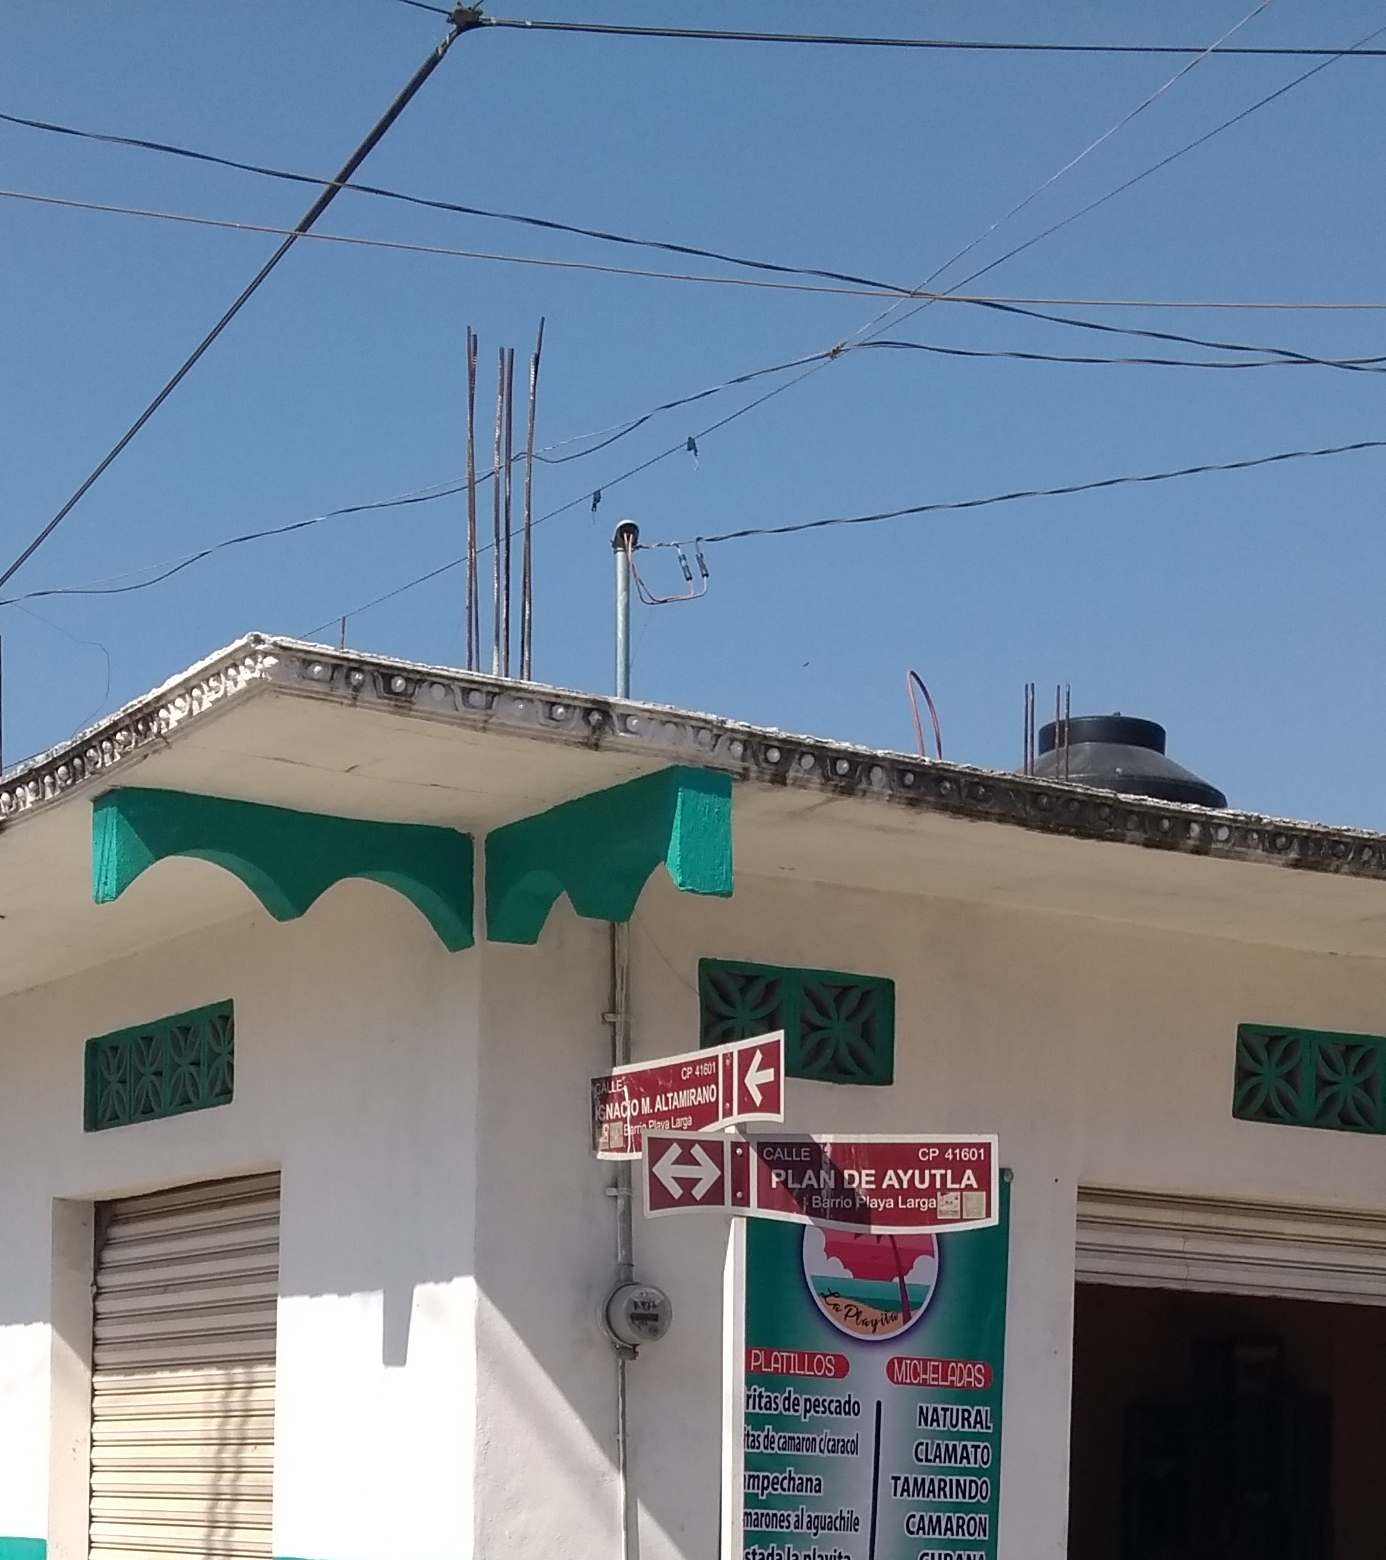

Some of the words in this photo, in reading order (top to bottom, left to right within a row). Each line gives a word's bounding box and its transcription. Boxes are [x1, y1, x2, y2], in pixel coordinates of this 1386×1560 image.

[695, 1061, 716, 1077] 41601
[595, 1079, 623, 1095] CALLE
[595, 1099, 639, 1122] IGNACIO
[641, 1096, 653, 1115] M.
[655, 1084, 717, 1112] ALTAMIRANO
[624, 1122, 647, 1136] Barrio
[648, 1119, 670, 1130] Playa
[671, 1115, 693, 1130] Larga
[762, 1147, 811, 1162] CALLE
[918, 1147, 940, 1162] CP
[944, 1147, 985, 1162] 41601
[771, 1169, 836, 1189] PLAN
[843, 1169, 876, 1189] DE
[882, 1169, 979, 1190] AYUTLA
[812, 1195, 853, 1210] Barrio
[856, 1195, 895, 1213] Playa
[898, 1195, 937, 1213] Larga
[820, 1287, 842, 1312] La
[843, 1304, 899, 1334] Playita
[750, 1349, 835, 1377] PLATILLOS
[893, 1359, 985, 1388] MICHELADAS
[744, 1386, 780, 1412] ritas
[782, 1390, 801, 1413] de
[803, 1395, 861, 1422] pescado
[918, 1405, 992, 1431] NATURAL
[743, 1426, 761, 1450] itas
[762, 1426, 776, 1451] de
[777, 1436, 817, 1454] camaron
[818, 1430, 859, 1456] c/caracol
[914, 1441, 990, 1466] CLAMATO
[891, 1476, 989, 1500] TAMARINDO
[743, 1510, 791, 1530] marones
[794, 1507, 805, 1530] al
[805, 1509, 860, 1538] aguachile
[905, 1514, 988, 1538] CAMARON
